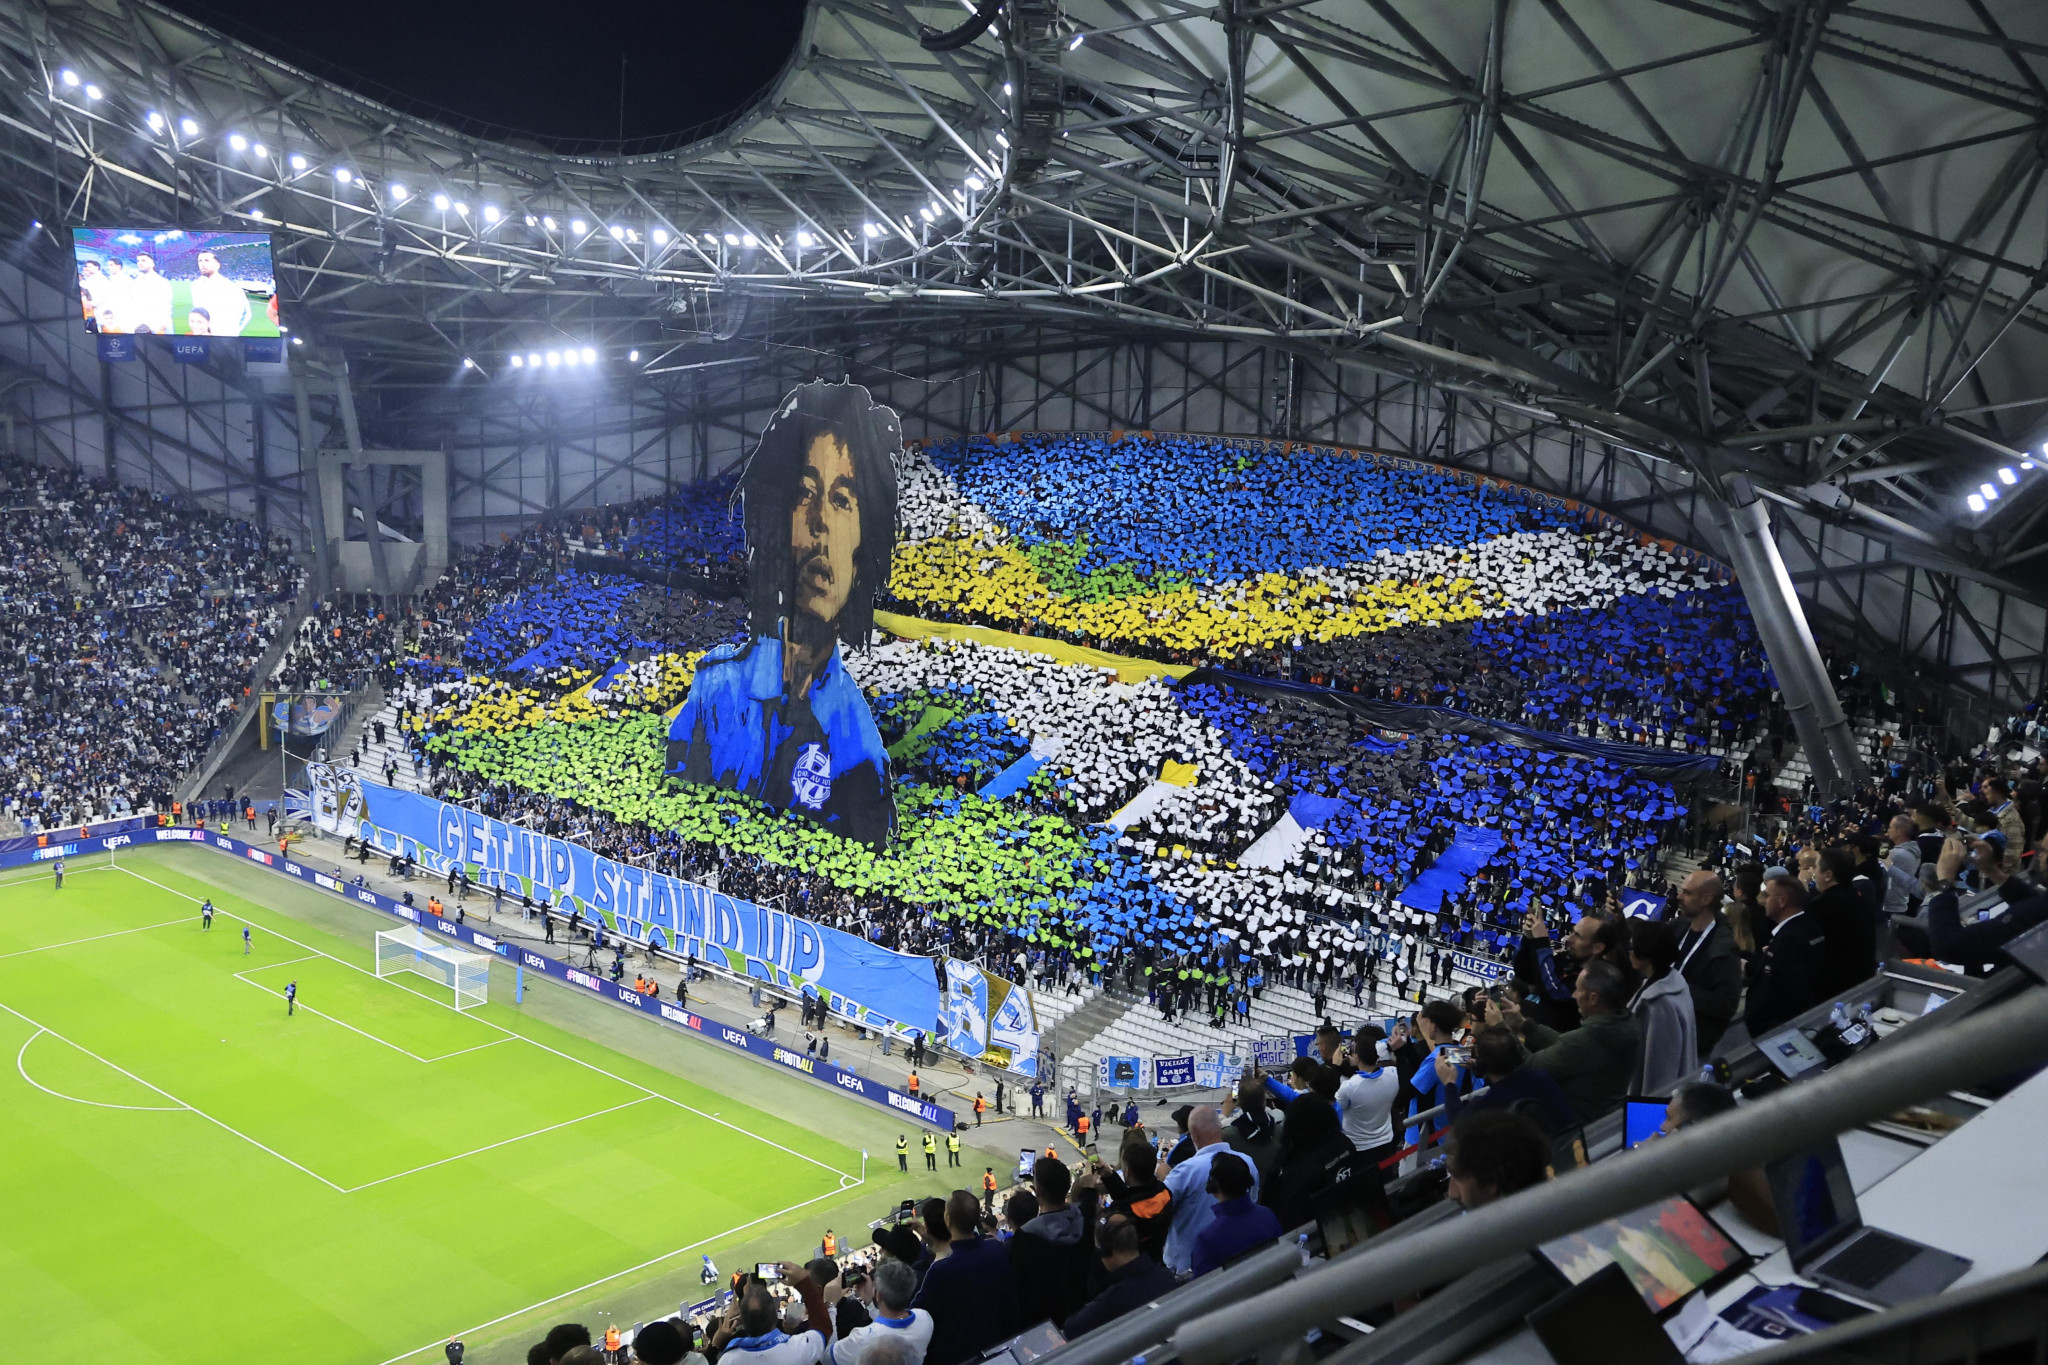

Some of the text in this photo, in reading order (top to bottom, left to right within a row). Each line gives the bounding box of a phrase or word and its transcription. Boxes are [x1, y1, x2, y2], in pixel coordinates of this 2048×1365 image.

[177, 346, 204, 354] UEFA
[102, 835, 131, 849] UEFA
[156, 829, 205, 841] WELCOME ALL
[217, 837, 232, 850] UEFA
[32, 843, 78, 861] #FOOTBALL
[285, 862, 302, 876] UEFA
[335, 880, 344, 893] ALL
[439, 802, 514, 872] GET
[521, 830, 576, 890] UP
[593, 855, 743, 952] STAND
[757, 906, 825, 983] UP
[358, 890, 376, 905] UEFA
[437, 920, 457, 936] UEFA
[524, 953, 546, 970] UEFA
[1452, 953, 1490, 976] ALLEZ
[566, 969, 600, 992] #FOOTBALL
[618, 989, 642, 1007] UEFA
[661, 1004, 702, 1031] WELCOME ALL
[944, 958, 1041, 1079] 84
[722, 1028, 748, 1048] UEFA
[1253, 1040, 1287, 1053] OM IS
[772, 1047, 814, 1074] #FOOTBALL
[1159, 1058, 1190, 1067] VIEILLE
[1254, 1051, 1285, 1063] MAGIC
[1162, 1067, 1190, 1076] GARDE
[1200, 1063, 1222, 1071] ALLEZ
[836, 1072, 864, 1093] UEFA
[888, 1091, 938, 1123] WELCOME ALL
